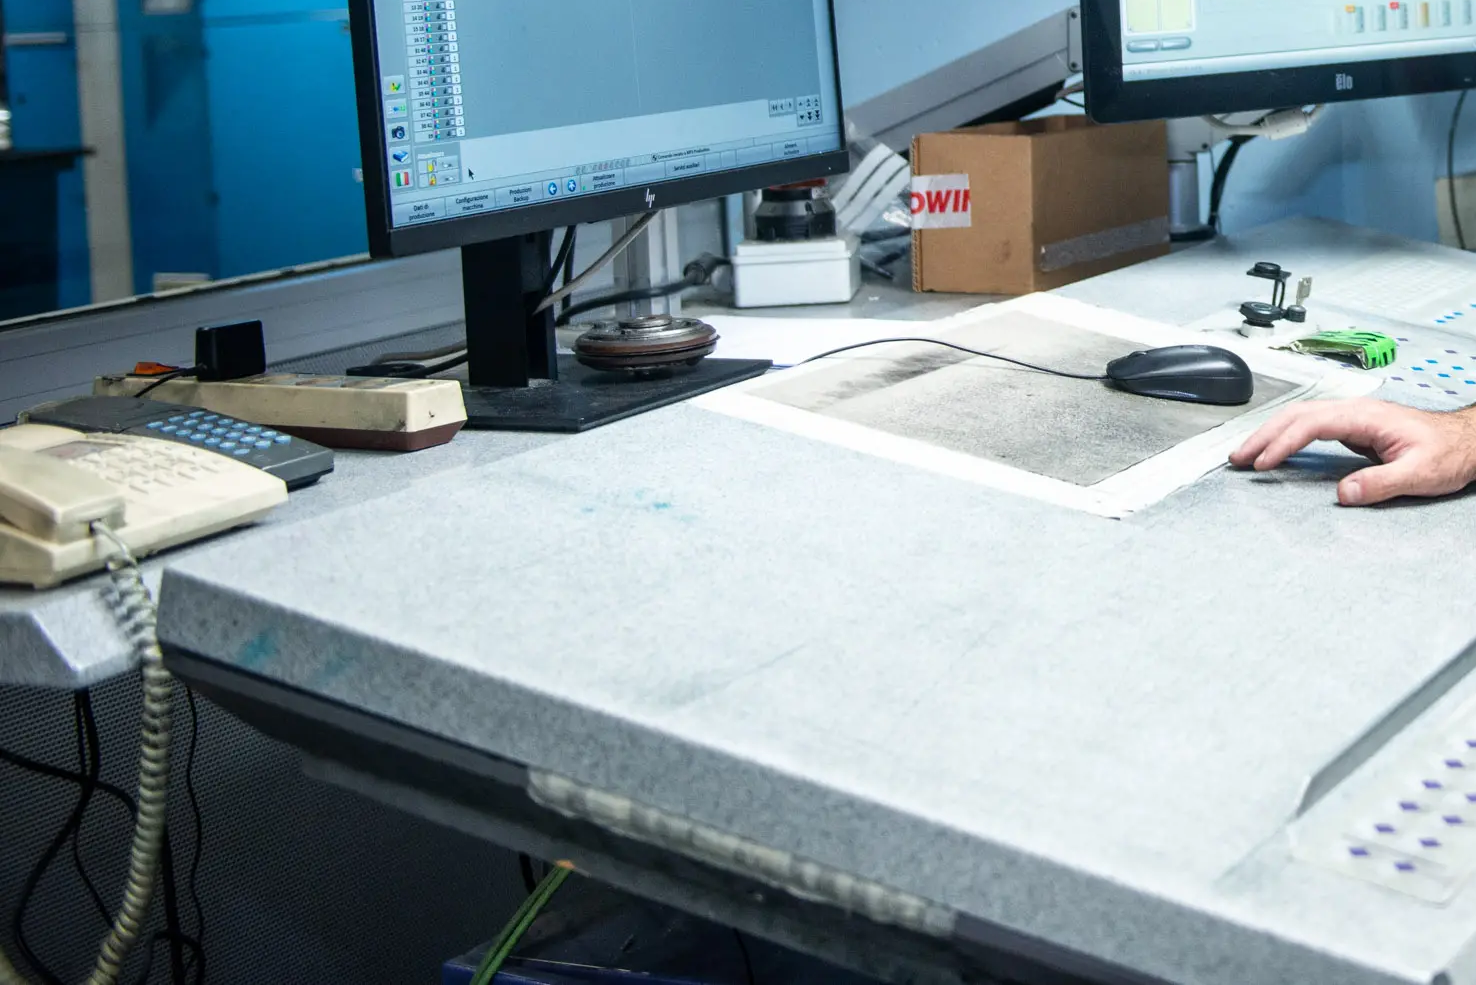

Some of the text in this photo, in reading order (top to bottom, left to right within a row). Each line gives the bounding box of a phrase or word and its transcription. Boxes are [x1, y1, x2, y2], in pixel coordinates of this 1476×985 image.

[456, 194, 488, 204] Configurazione
[645, 188, 656, 208] hp
[408, 212, 435, 221] produzione
